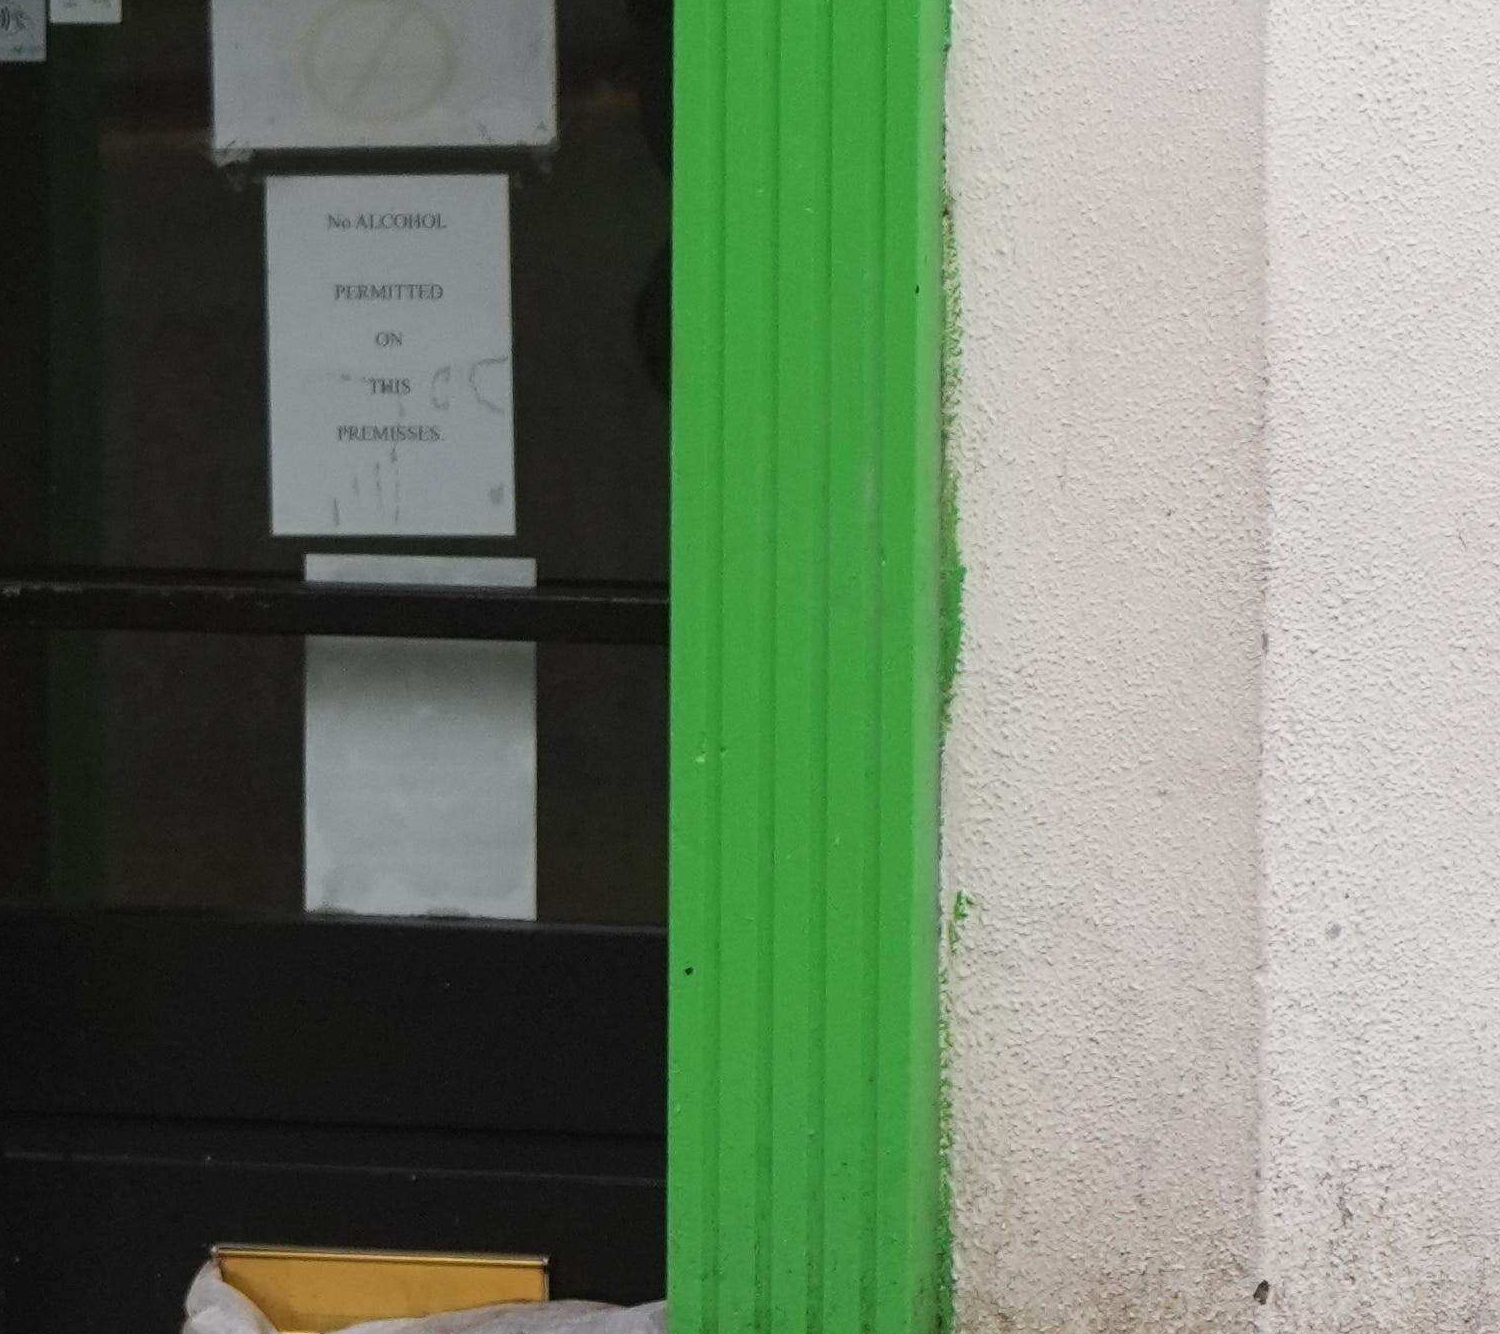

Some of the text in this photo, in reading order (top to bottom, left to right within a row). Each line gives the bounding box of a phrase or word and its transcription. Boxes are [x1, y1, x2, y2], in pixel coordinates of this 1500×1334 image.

[327, 214, 448, 229] No ALCOHOL
[334, 283, 445, 301] PERMITTED
[374, 331, 403, 347] ON
[369, 378, 412, 395] THIS
